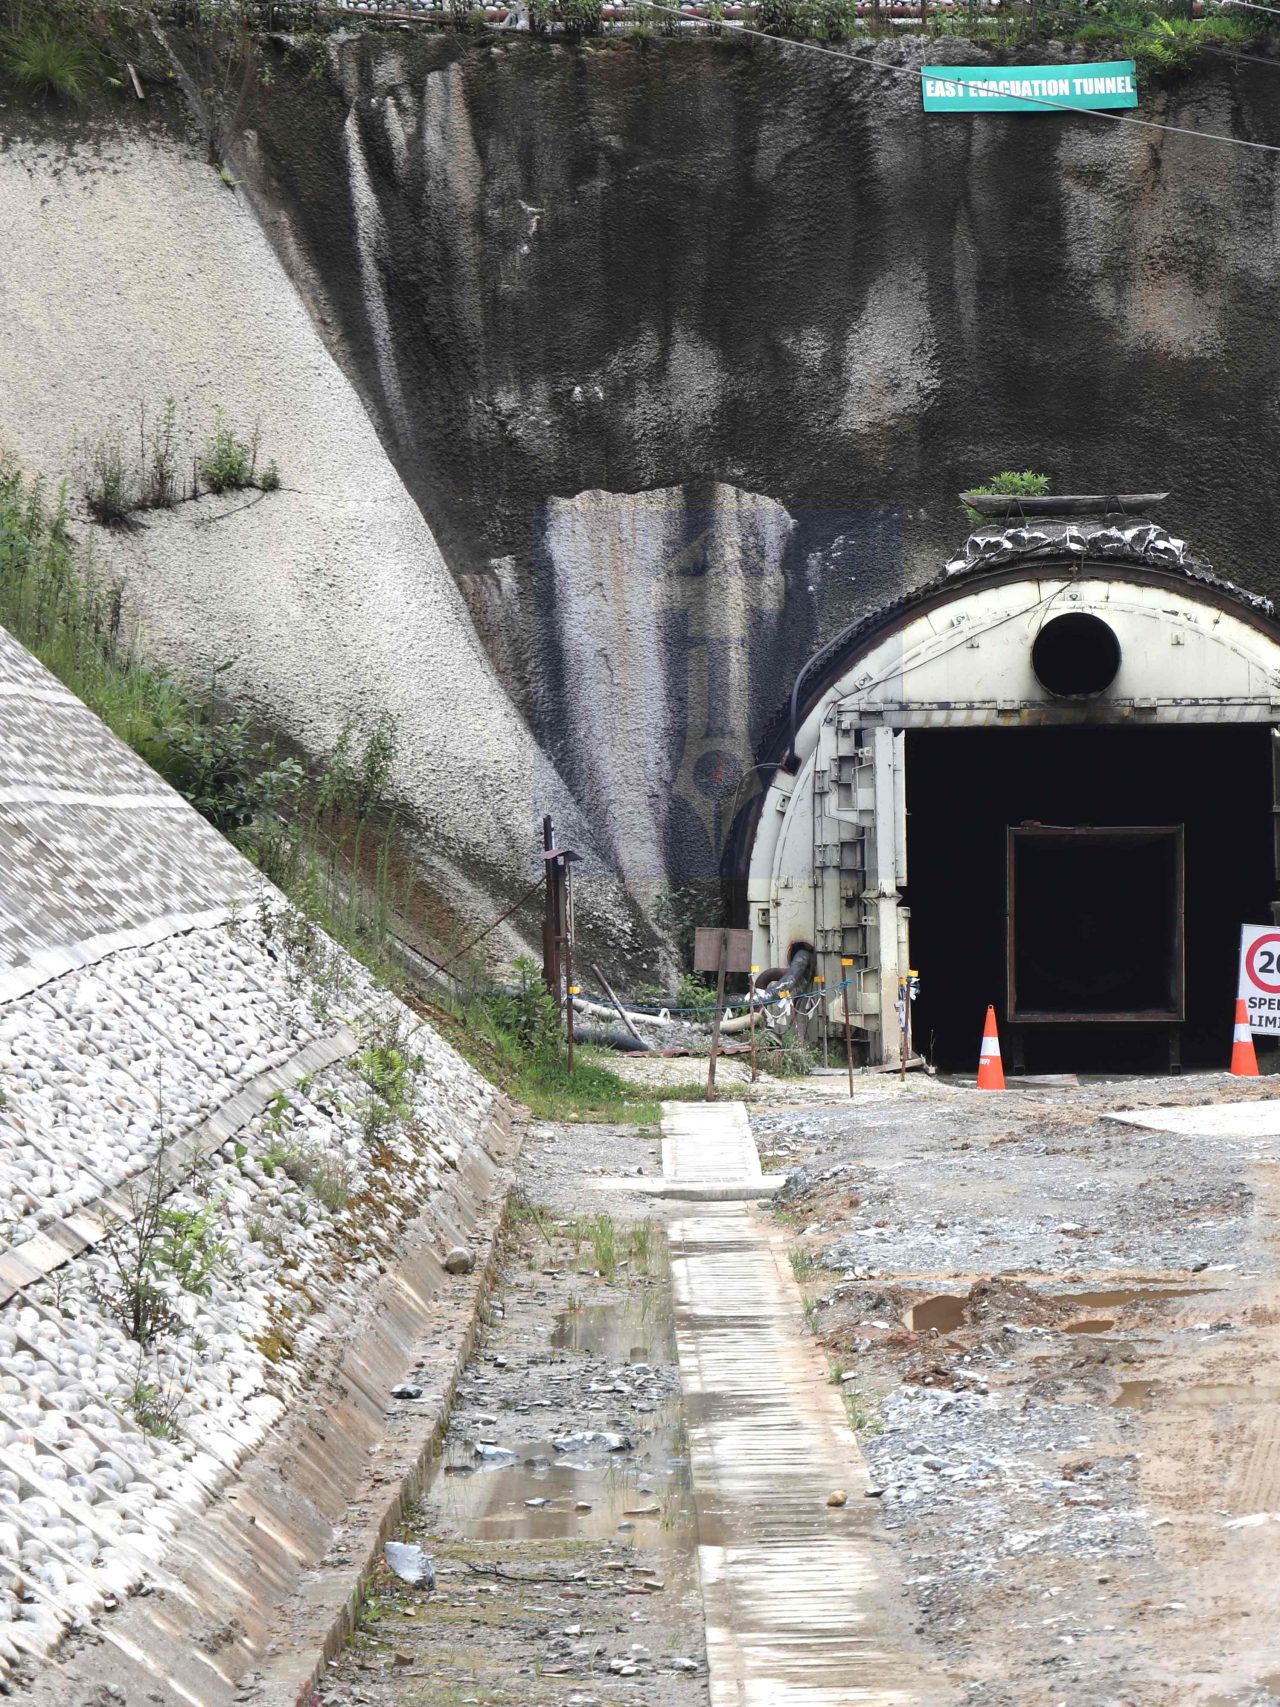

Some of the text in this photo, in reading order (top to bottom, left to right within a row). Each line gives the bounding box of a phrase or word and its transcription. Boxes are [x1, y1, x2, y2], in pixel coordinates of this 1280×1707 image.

[926, 76, 1133, 97] EAST EVACUATION TUNNEL
